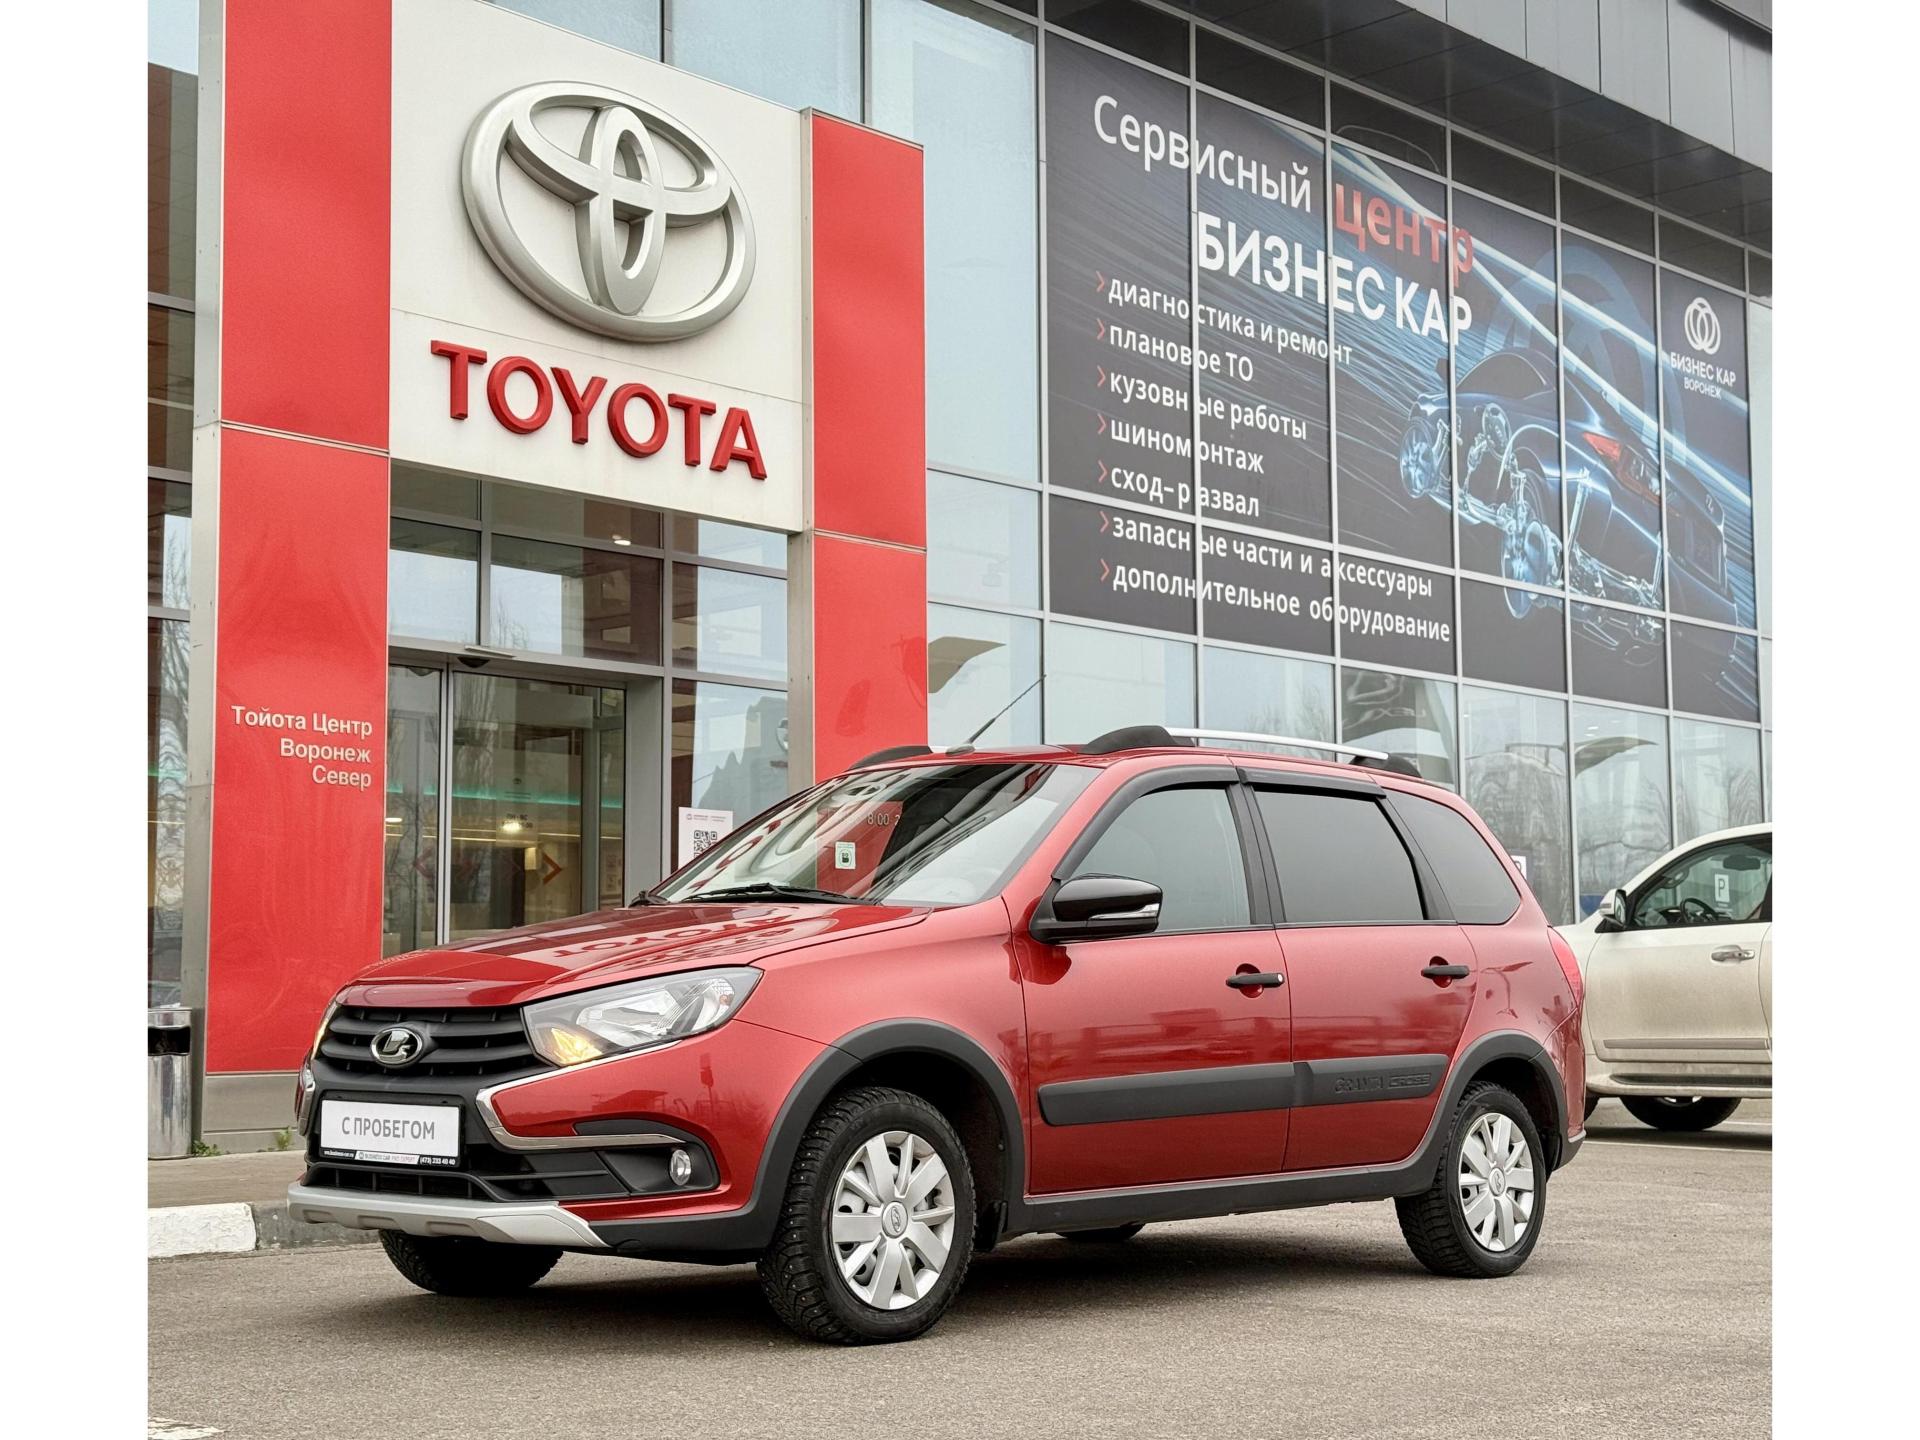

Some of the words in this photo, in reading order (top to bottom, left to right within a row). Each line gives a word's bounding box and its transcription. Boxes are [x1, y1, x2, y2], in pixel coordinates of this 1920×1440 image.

[1094, 95, 1311, 212] Сервисный
[1335, 183, 1473, 287] центр
[1198, 211, 1386, 321] БИЗНЕС
[1396, 277, 1472, 346] КАР
[1109, 277, 1255, 339] диагностика
[1260, 323, 1273, 343] и
[1278, 329, 1352, 365] ремонт
[1110, 325, 1220, 374] плановое
[1225, 352, 1254, 382] ТО
[1670, 352, 1714, 380] БИЗНЕС
[1716, 367, 1736, 388] КАР
[430, 340, 767, 480] TOYOTA
[1110, 372, 1225, 420] кузовные
[1230, 401, 1307, 440] работы
[1684, 377, 1722, 400] ВОРОНЕЖ
[1111, 418, 1264, 474] шиномонтаж
[1111, 466, 1260, 517] сход-развал
[1112, 516, 1228, 557] запасные
[1233, 538, 1293, 570] части
[1301, 553, 1313, 574] и
[1321, 558, 1433, 598] аксессуары
[1113, 564, 1300, 616] дополнительное
[1309, 597, 1451, 643] оборудование
[231, 705, 307, 731] Тойота
[312, 712, 373, 740] Центр
[280, 737, 371, 764] Воронеж
[312, 764, 372, 791] Север
[342, 1116, 351, 1135] С
[353, 1117, 435, 1140] ПРОБЕГОМ
